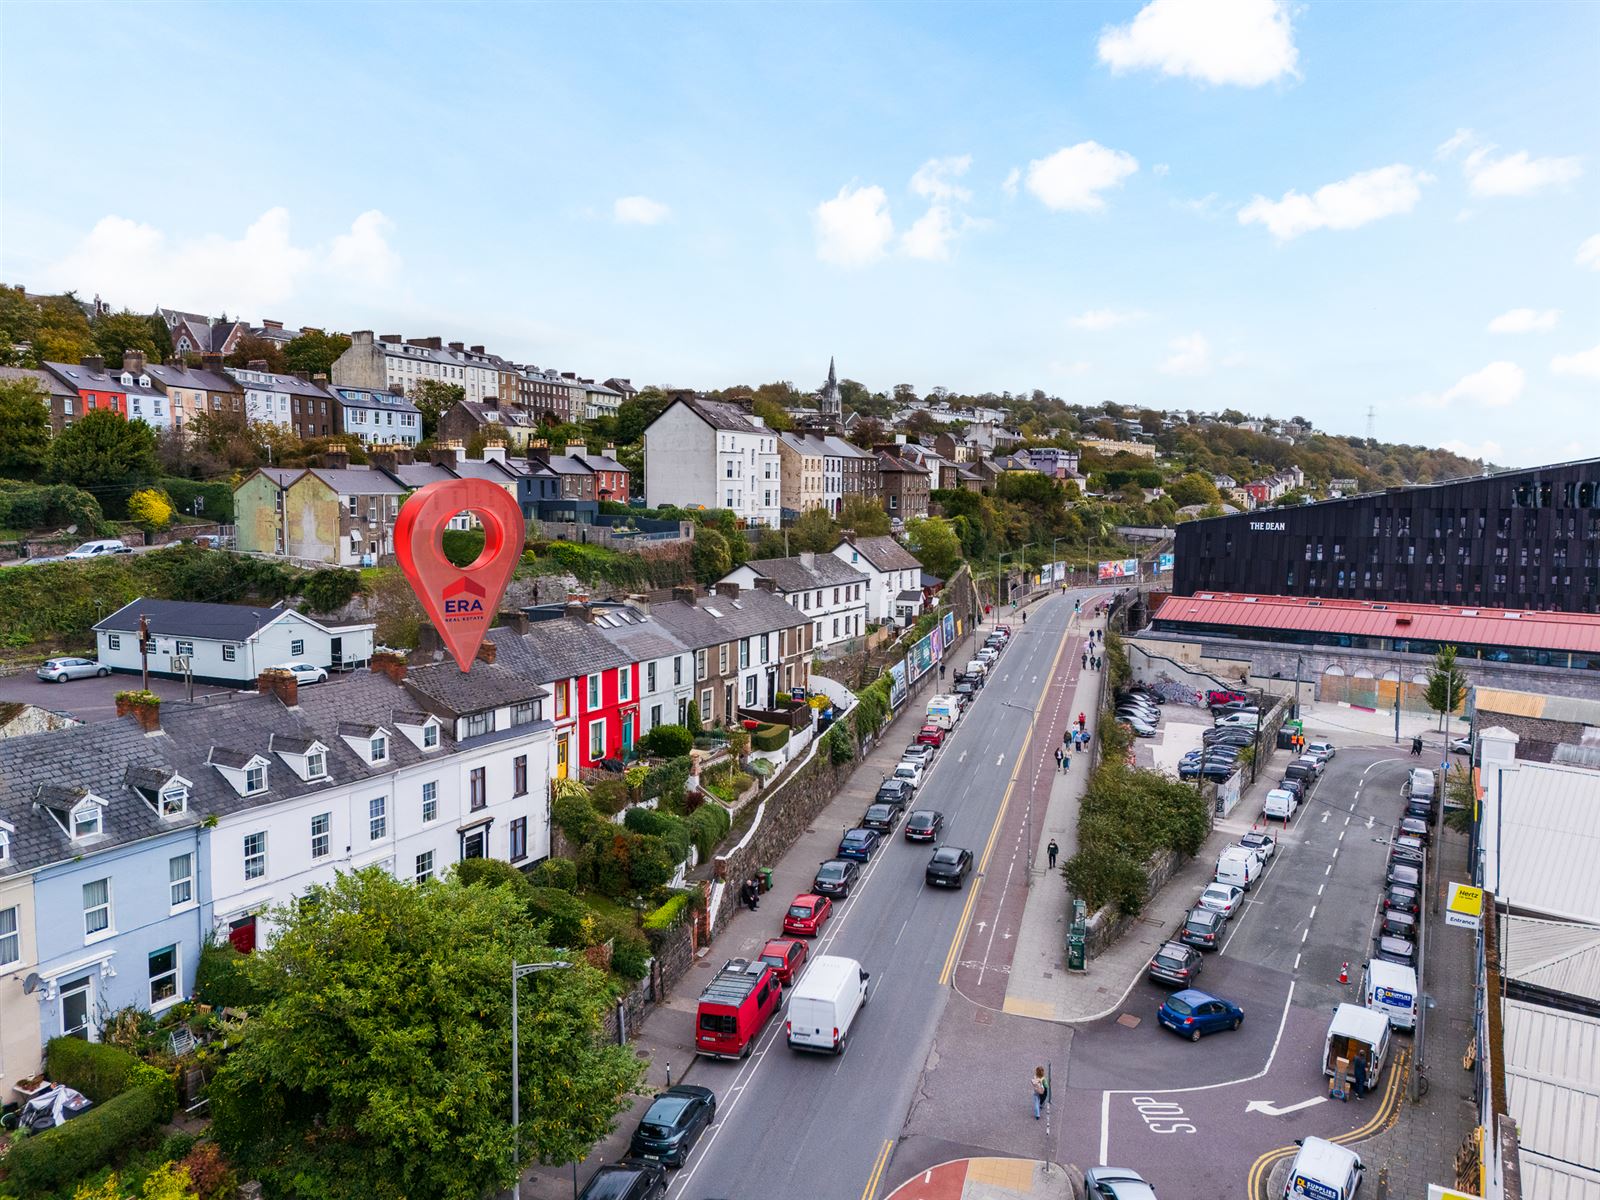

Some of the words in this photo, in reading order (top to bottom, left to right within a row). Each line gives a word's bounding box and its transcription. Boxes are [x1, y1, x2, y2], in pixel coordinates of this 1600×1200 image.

[1250, 521, 1264, 530] THE
[1265, 522, 1286, 530] DEAN
[1459, 889, 1479, 899] Hertz
[1450, 916, 1475, 925] Entrance
[1132, 1096, 1197, 1133] STOP
[1306, 1181, 1337, 1198] SUPPLIES
